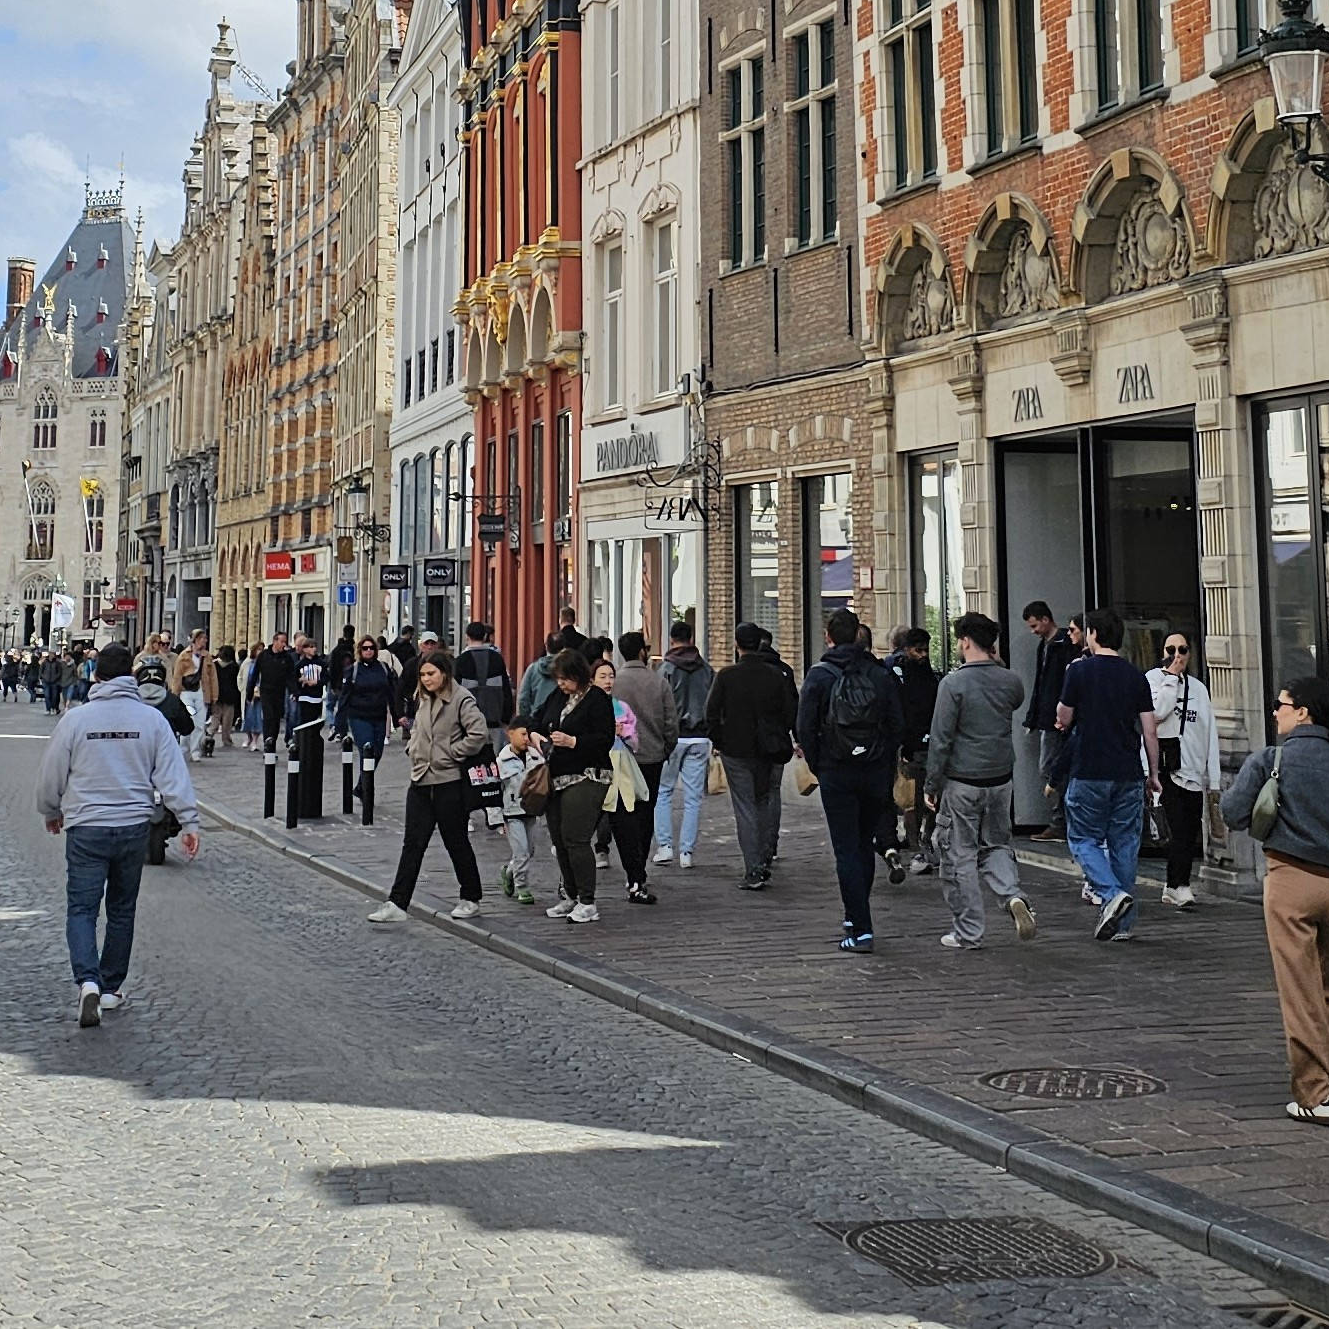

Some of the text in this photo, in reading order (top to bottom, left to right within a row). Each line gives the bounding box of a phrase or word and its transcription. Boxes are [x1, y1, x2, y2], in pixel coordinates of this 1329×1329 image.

[1116, 362, 1155, 404] ZARA
[1012, 384, 1044, 423] ZARA
[596, 430, 657, 472] PANDORA
[266, 563, 291, 571] HEMA
[382, 573, 406, 581] ONLY
[427, 568, 452, 577] ONLY
